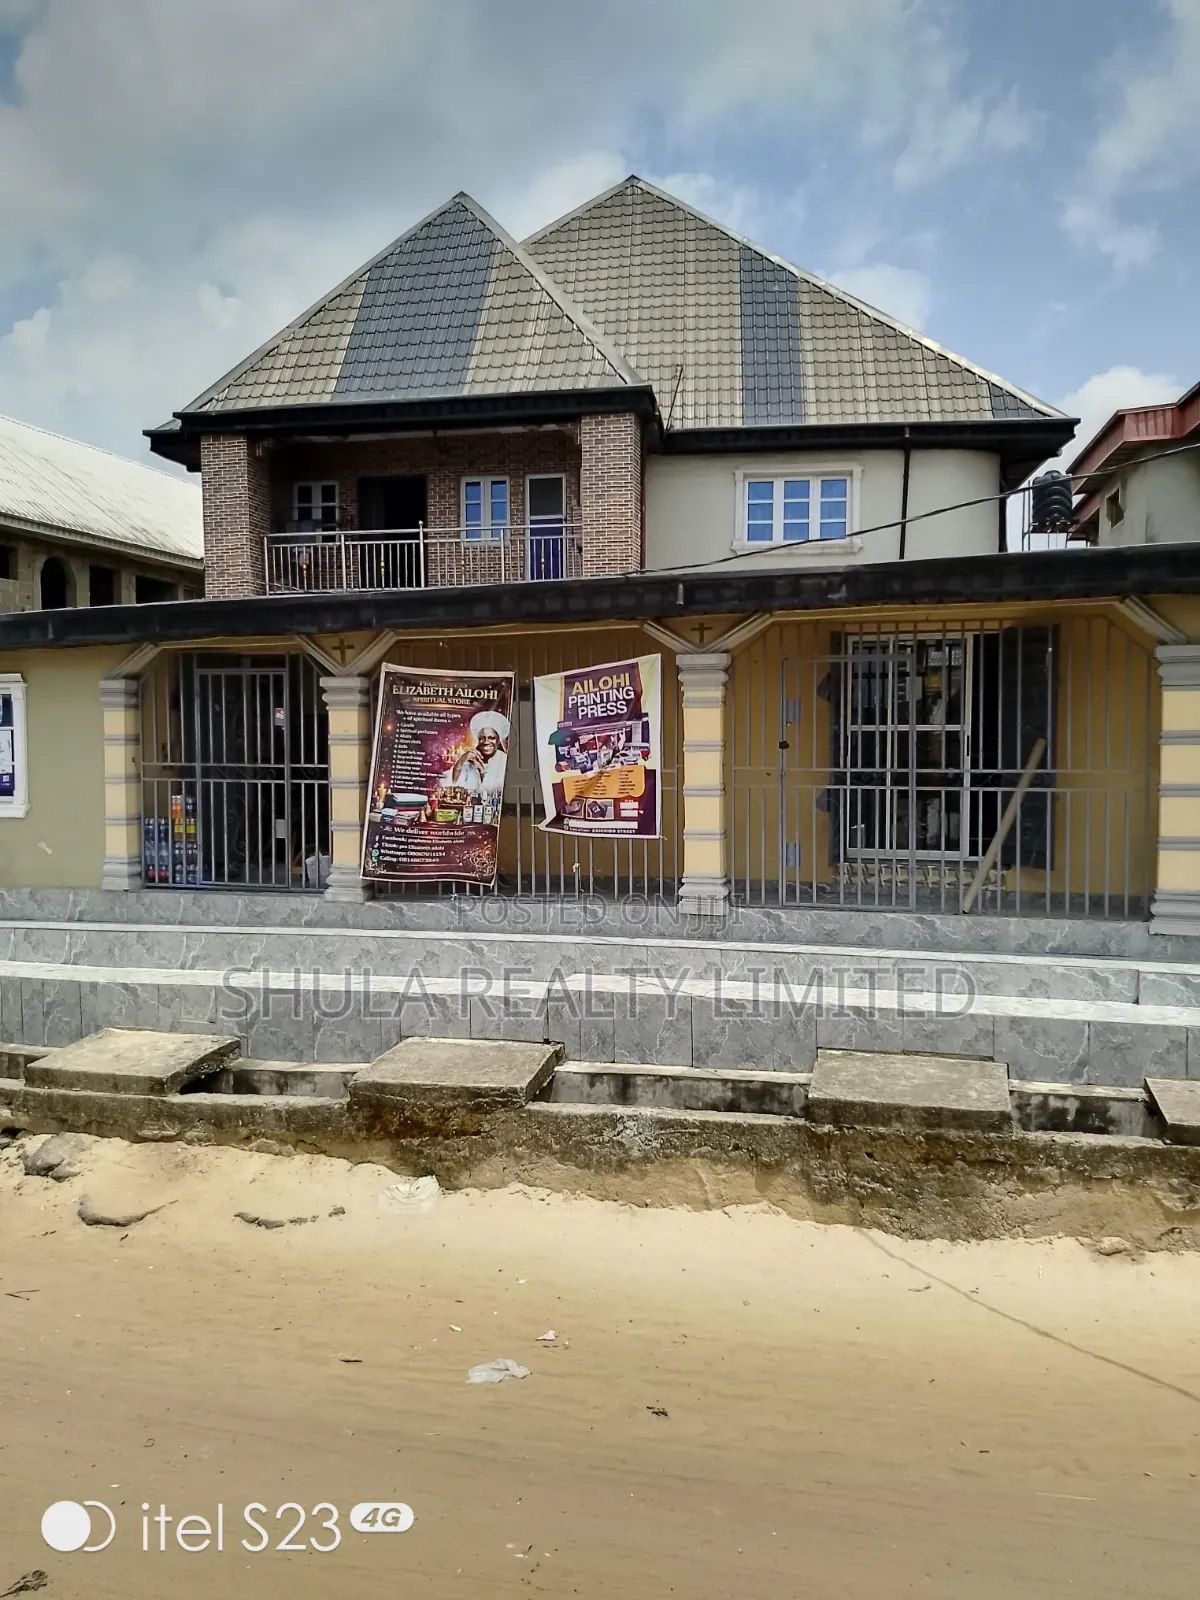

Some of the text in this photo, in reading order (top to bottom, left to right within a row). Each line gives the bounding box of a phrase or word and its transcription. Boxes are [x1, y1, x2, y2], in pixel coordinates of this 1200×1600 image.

[392, 685, 498, 700] ELIZABETH AILOHI
[572, 672, 630, 695] AILOHI
[568, 686, 635, 708] PRINTING
[578, 701, 628, 720] PRESS
